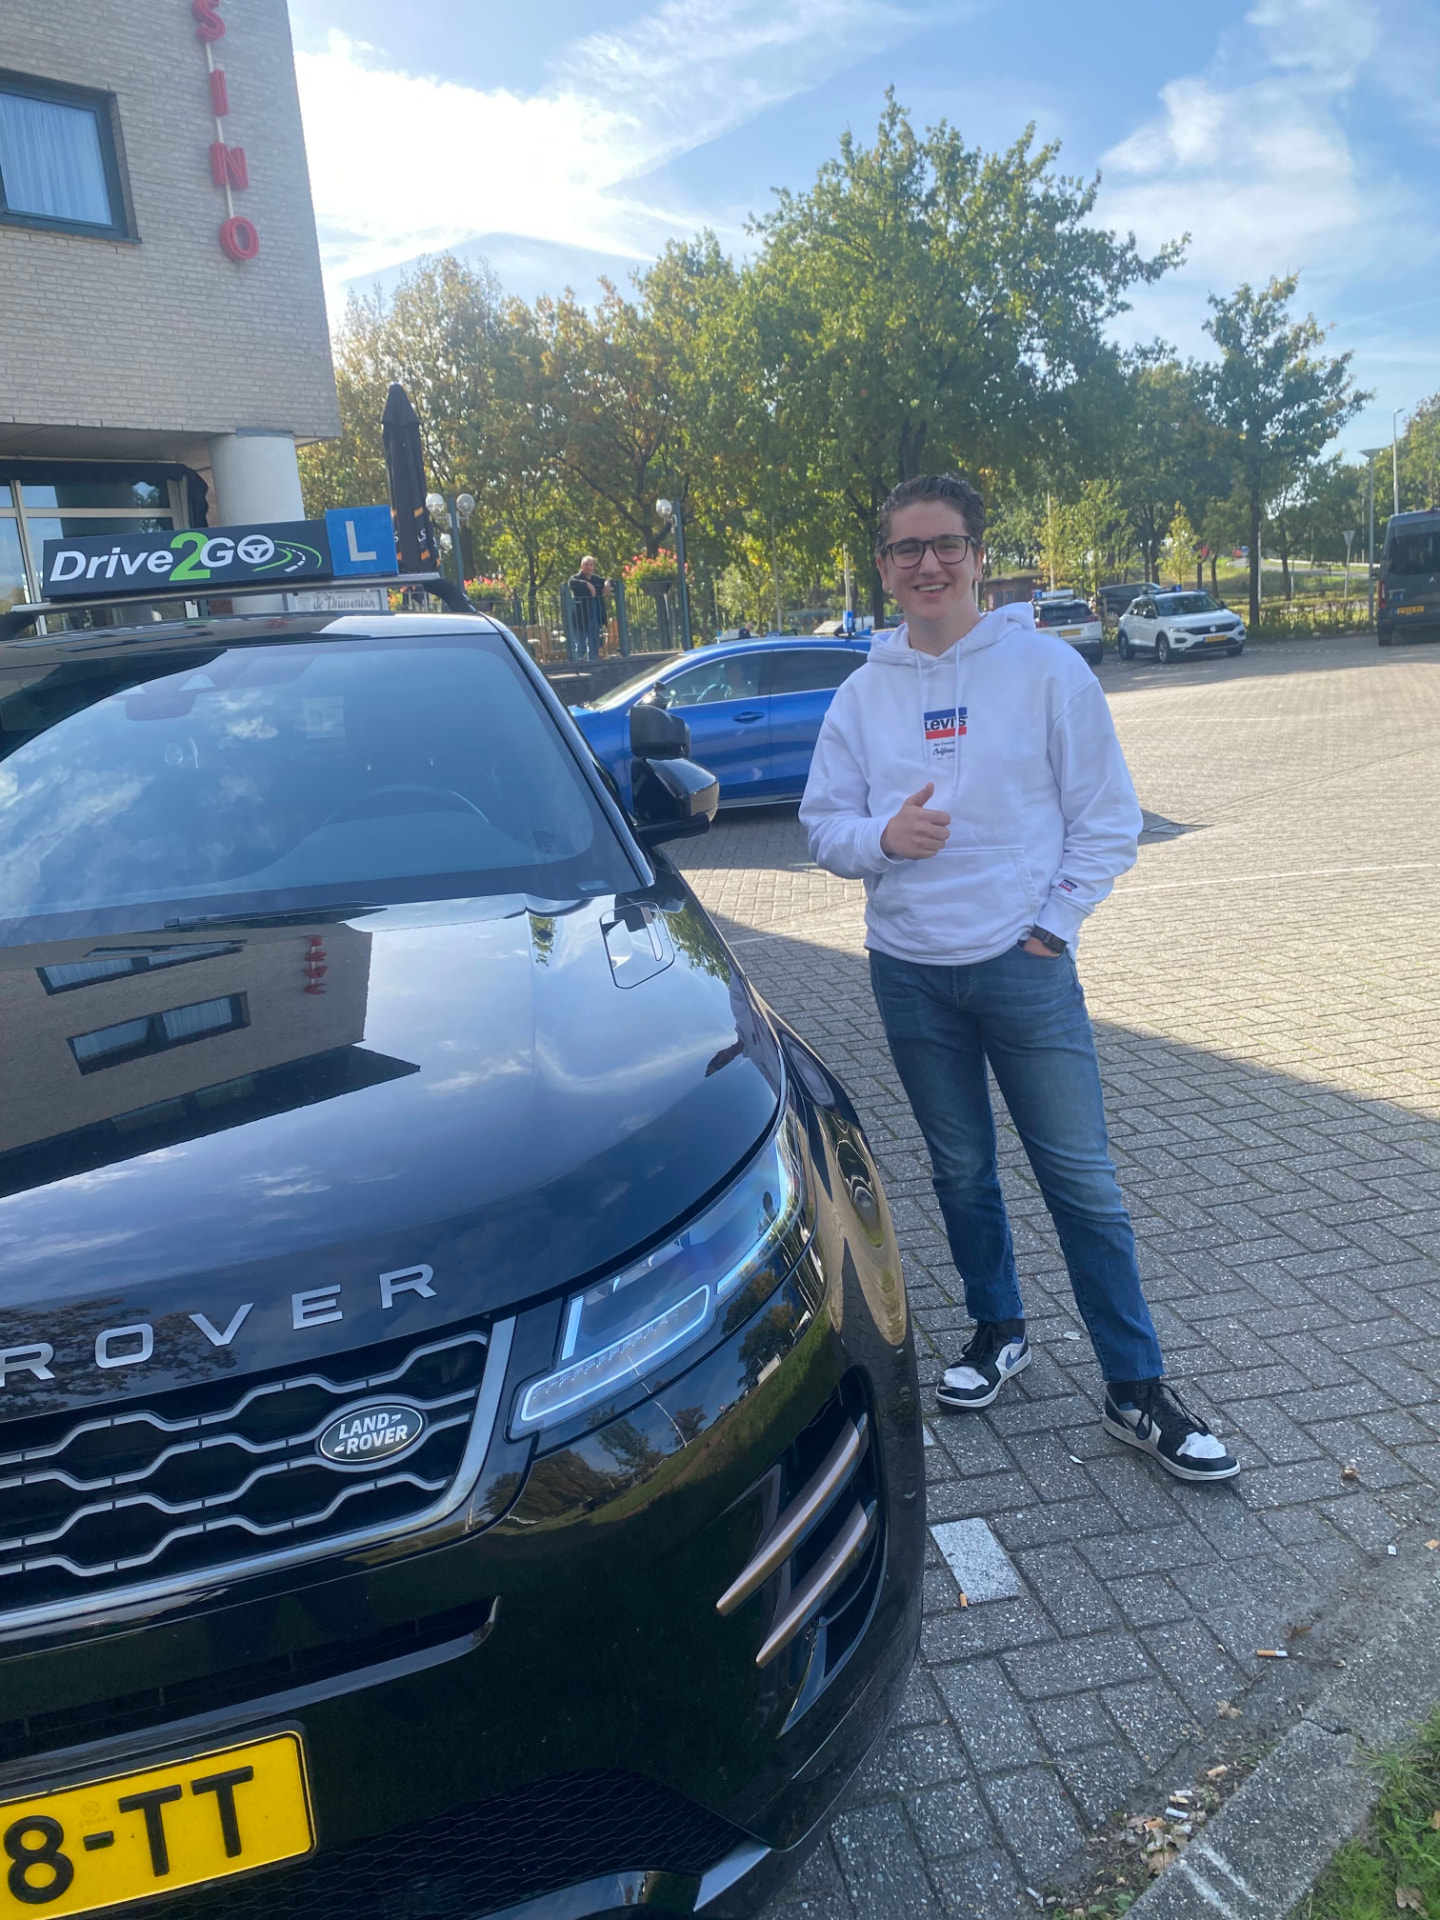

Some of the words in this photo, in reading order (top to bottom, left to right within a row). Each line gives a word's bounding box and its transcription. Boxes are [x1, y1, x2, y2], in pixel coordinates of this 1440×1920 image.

[345, 520, 377, 562] L
[0, 1263, 437, 1388] ROVER
[338, 1413, 390, 1440] LAND
[346, 1425, 408, 1455] ROVER
[3, 1765, 254, 1905] 8-TT
